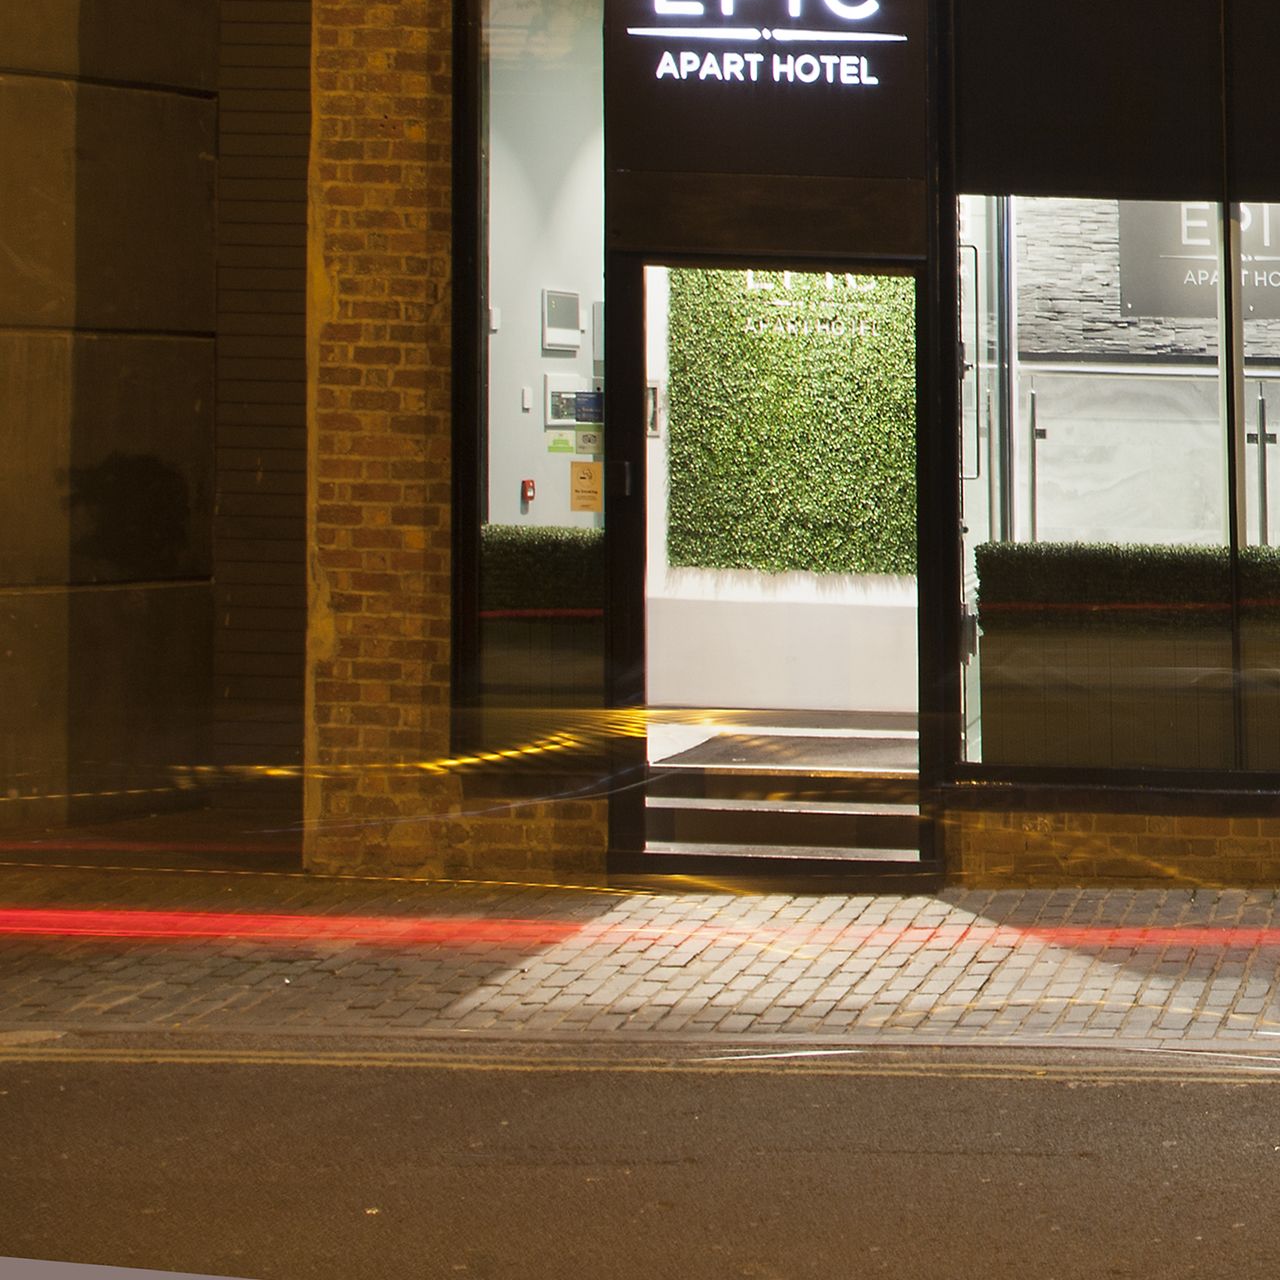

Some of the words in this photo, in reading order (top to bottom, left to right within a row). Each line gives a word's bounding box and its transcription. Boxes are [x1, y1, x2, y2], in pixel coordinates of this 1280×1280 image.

[656, 51, 764, 82] APART
[772, 53, 879, 85] HOTEL
[1183, 269, 1249, 288] APAT
